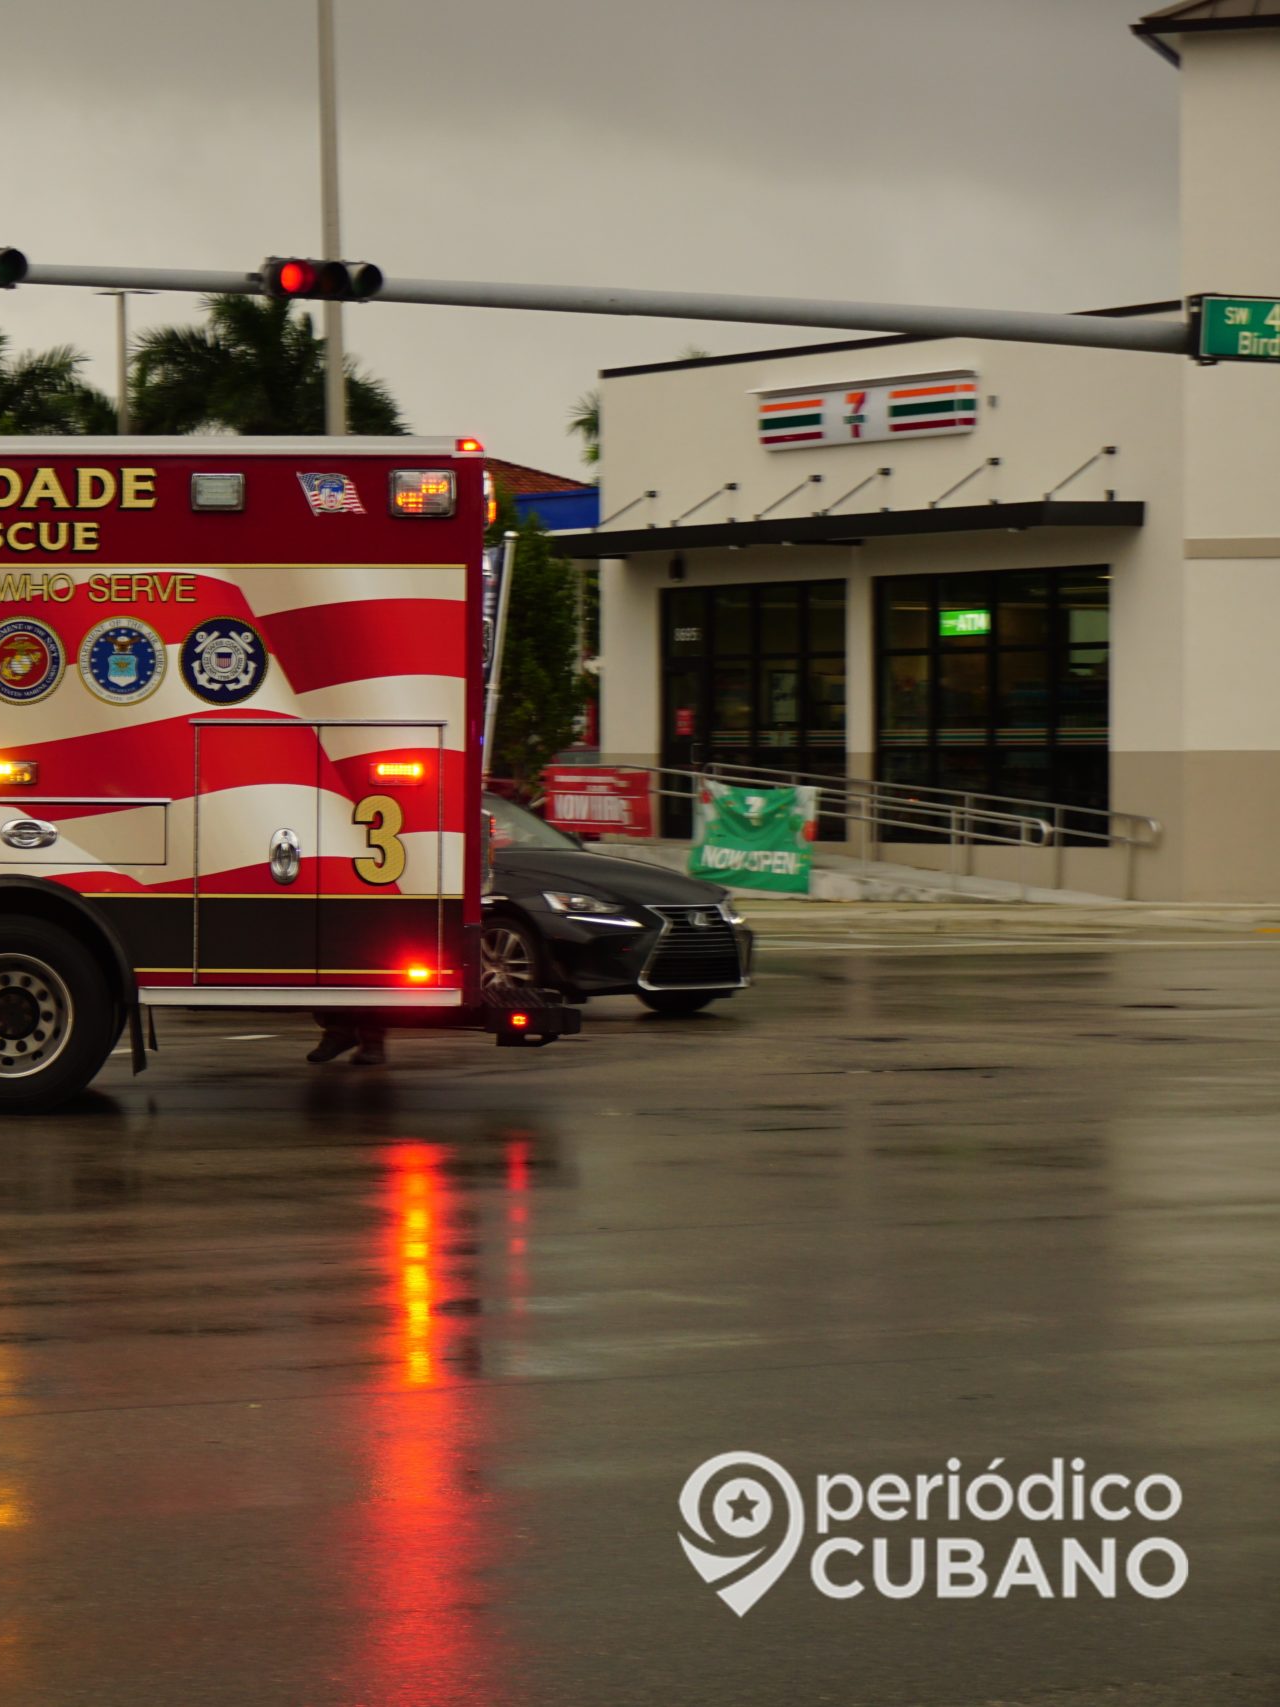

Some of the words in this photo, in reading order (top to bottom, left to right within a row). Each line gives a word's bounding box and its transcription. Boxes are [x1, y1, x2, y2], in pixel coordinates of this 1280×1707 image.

[1224, 306, 1249, 325] SW
[1237, 331, 1280, 356] Bird
[88, 573, 198, 603] SERVE
[352, 793, 406, 886] 3
